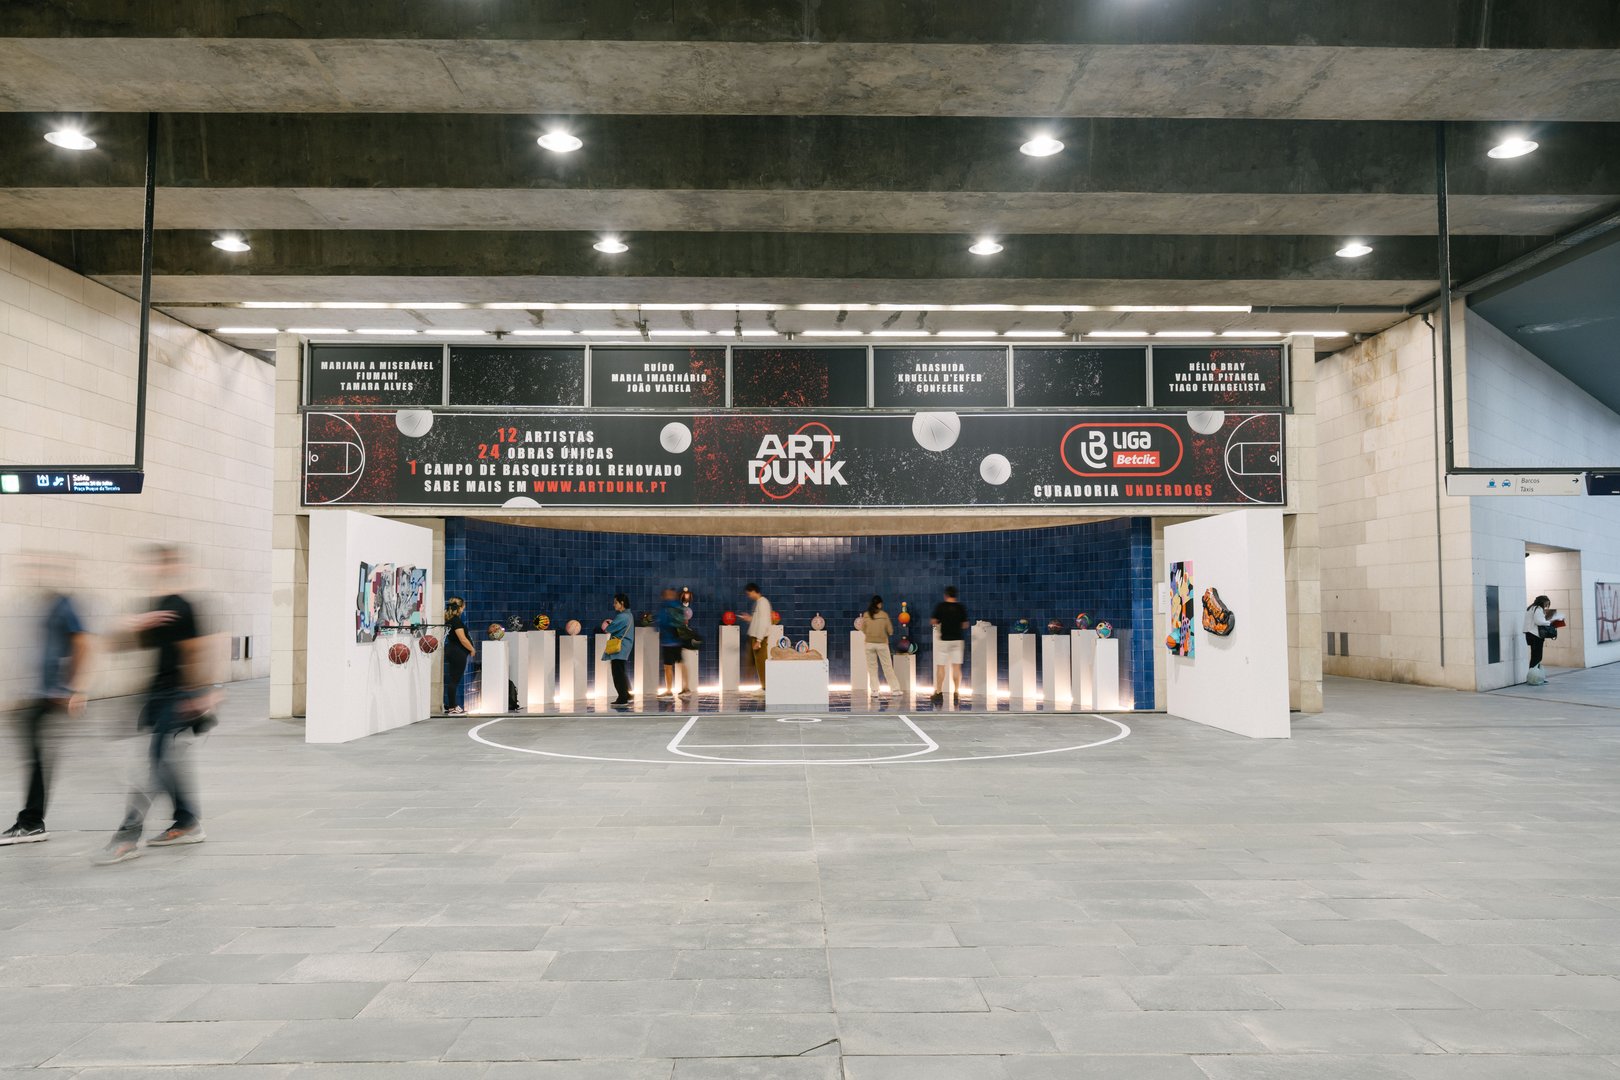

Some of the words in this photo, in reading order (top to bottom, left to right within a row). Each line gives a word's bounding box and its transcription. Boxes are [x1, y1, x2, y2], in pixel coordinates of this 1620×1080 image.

[320, 361, 365, 370] MARIANA
[369, 362, 376, 370] A
[379, 360, 434, 370] MISERÁVEL
[644, 362, 675, 372] RUÍDO
[916, 363, 964, 372] ARASHIDA
[1189, 361, 1217, 371] HÉLIO
[1220, 362, 1246, 371] BRAY
[356, 372, 398, 380] FIUMANI
[611, 373, 643, 382] MARIA
[646, 372, 707, 382] IMAGINÁRIO
[898, 374, 940, 382] KRUELLA
[943, 374, 982, 382] D'ENFER
[1175, 373, 1191, 382] VAI
[1195, 373, 1214, 382] DAR
[1218, 373, 1260, 382] PITANGA
[340, 382, 380, 391] TAMARA
[383, 382, 414, 391] ALVES
[627, 383, 651, 392] JOÃO
[655, 384, 691, 392] VARELA
[916, 384, 964, 393] CONFEERE
[1169, 383, 1198, 392] TIAGO
[1202, 383, 1266, 392] EVANGELISTA
[497, 428, 518, 443] 12
[525, 430, 595, 443] ARTISTAS
[755, 434, 841, 459] ART
[477, 444, 500, 460] 24
[507, 447, 554, 460] OBRAS
[560, 445, 614, 460] ÚNICAS
[1117, 454, 1156, 465] Betclic
[409, 461, 417, 475] 1
[424, 463, 473, 476] CAMPO
[480, 464, 497, 476] DE
[502, 464, 602, 477] BASQUETEBOL
[608, 465, 683, 477] RENOVADO
[748, 460, 848, 486] DUNK
[424, 480, 460, 492] SABE
[466, 480, 502, 492] MAIS
[508, 481, 527, 492] EM
[534, 481, 667, 493] WWW.ARTDUNK.PT
[1034, 484, 1119, 497] CURADORIA
[1125, 484, 1213, 497] UNDERDOGS
